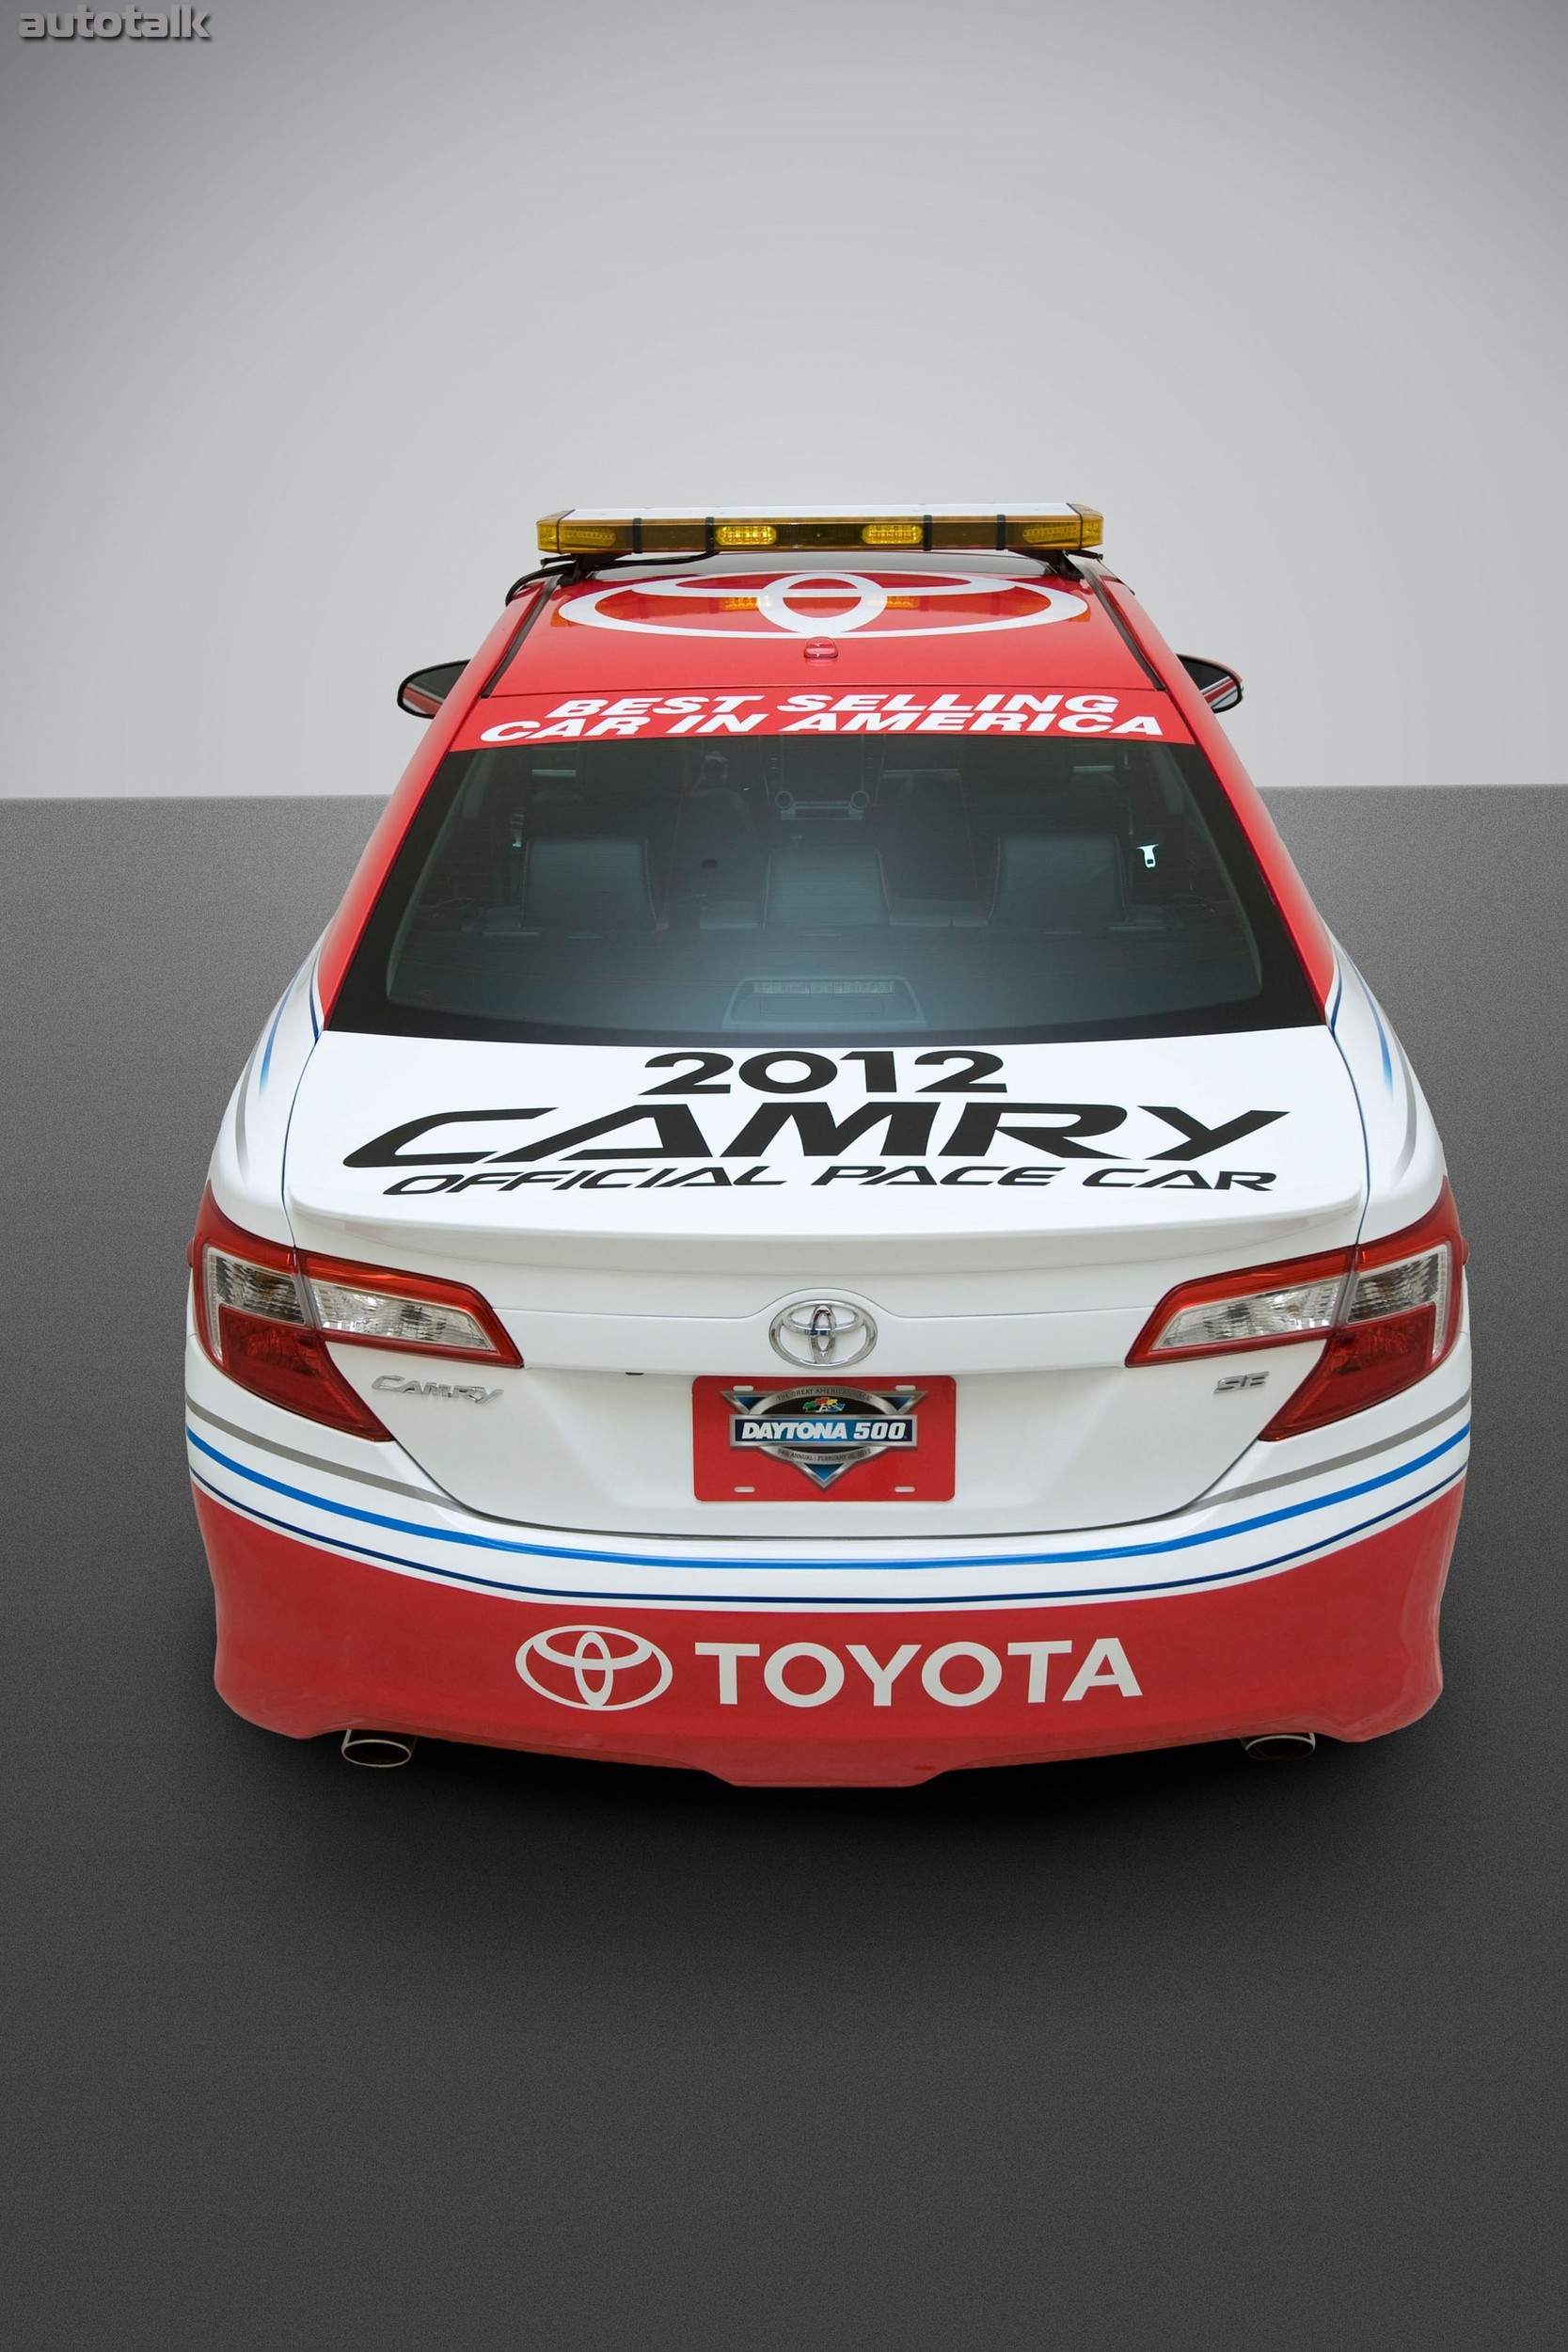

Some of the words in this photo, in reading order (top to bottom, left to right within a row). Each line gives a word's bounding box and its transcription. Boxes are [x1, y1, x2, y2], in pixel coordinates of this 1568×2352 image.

[545, 695, 765, 719] BEST
[777, 693, 1119, 713] SELLING
[480, 716, 651, 742] CAR
[665, 713, 769, 734] IN
[779, 712, 1164, 736] AMERICA
[640, 1050, 1008, 1096] 2012
[343, 1102, 1291, 1168] CAMRY
[382, 1166, 786, 1196] OFFICIAL
[811, 1166, 1066, 1186] PACE
[1082, 1168, 1277, 1192] CAR
[372, 1375, 504, 1404] CAMRY
[1213, 1371, 1270, 1393] SE
[741, 1422, 847, 1439] DAYTONA
[853, 1422, 906, 1439] 500
[790, 1453, 814, 1461] ANNUAL
[694, 1637, 1143, 1708] TOYOTA
